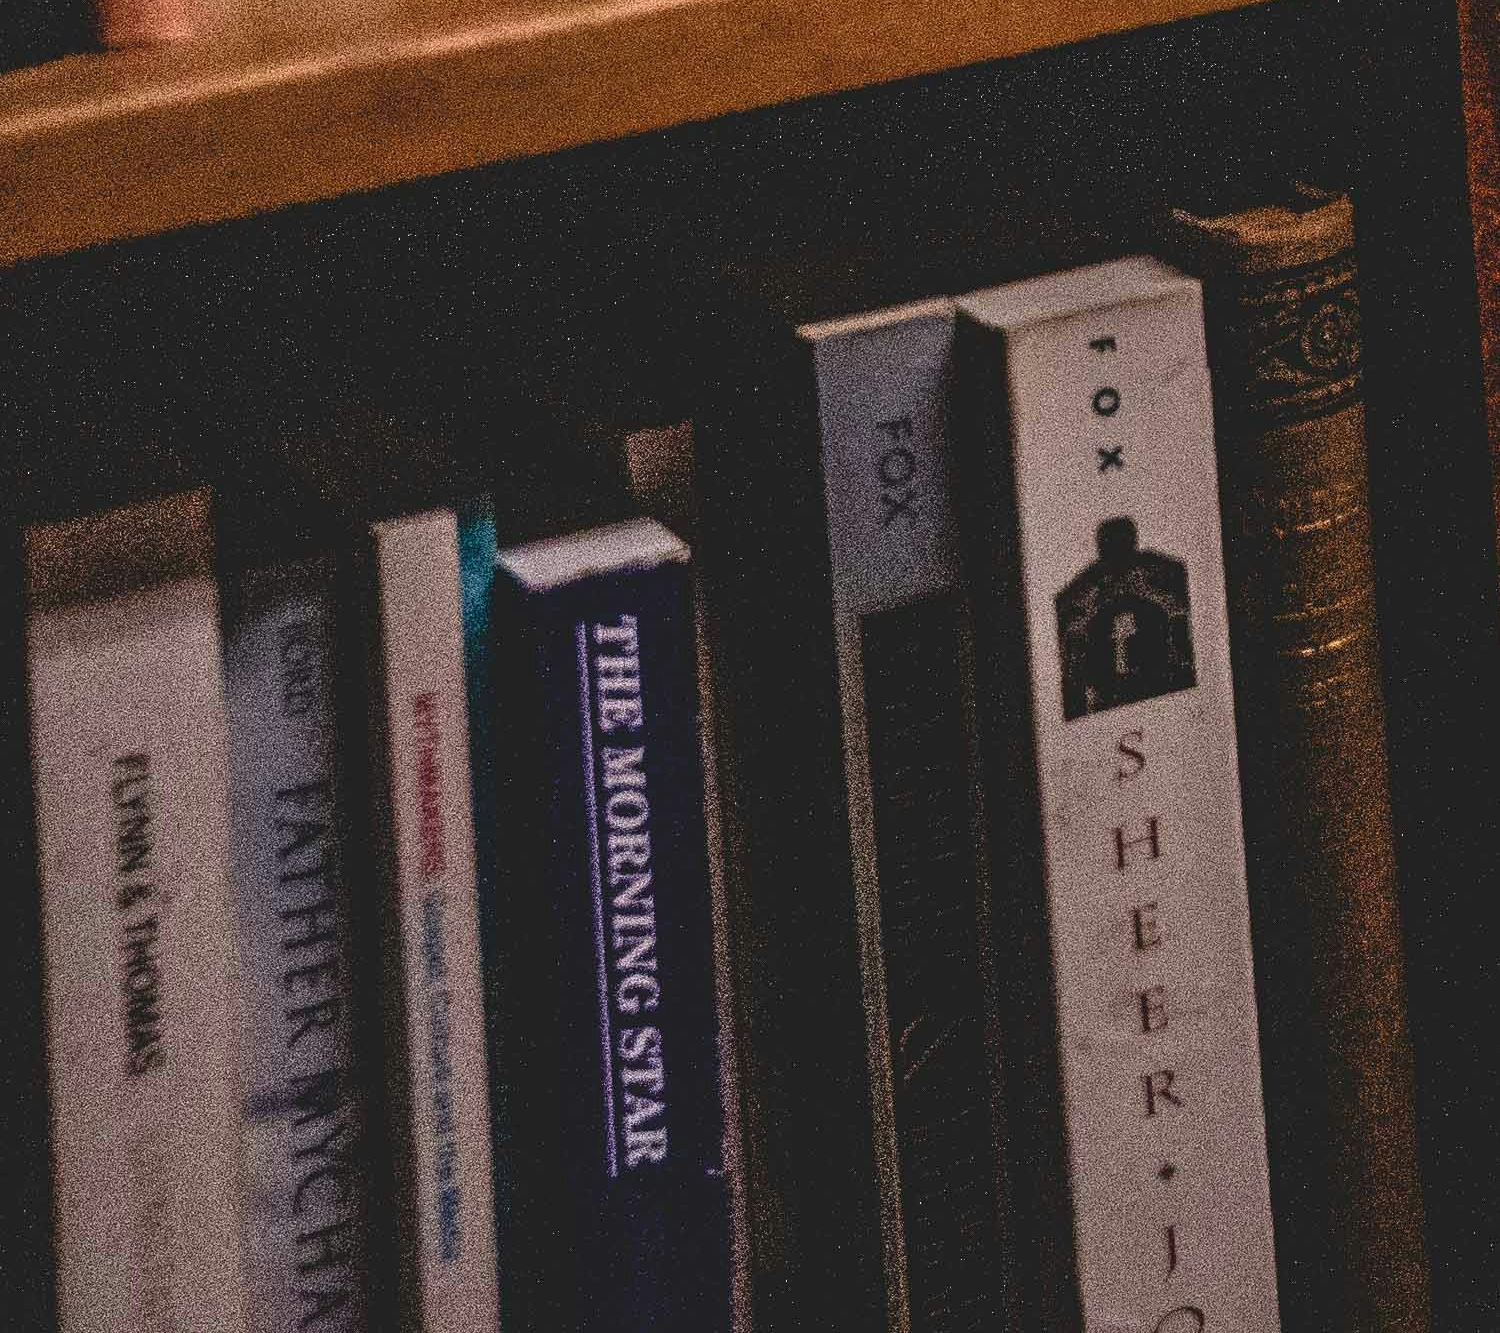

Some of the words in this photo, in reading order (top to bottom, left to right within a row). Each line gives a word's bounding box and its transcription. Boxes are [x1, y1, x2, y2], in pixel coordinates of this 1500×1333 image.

[1089, 336, 1124, 474] FOX
[593, 614, 642, 732] THE
[603, 745, 659, 1014] MORNING
[122, 918, 164, 1075] THOMAS
[621, 1028, 667, 1167] STAR
